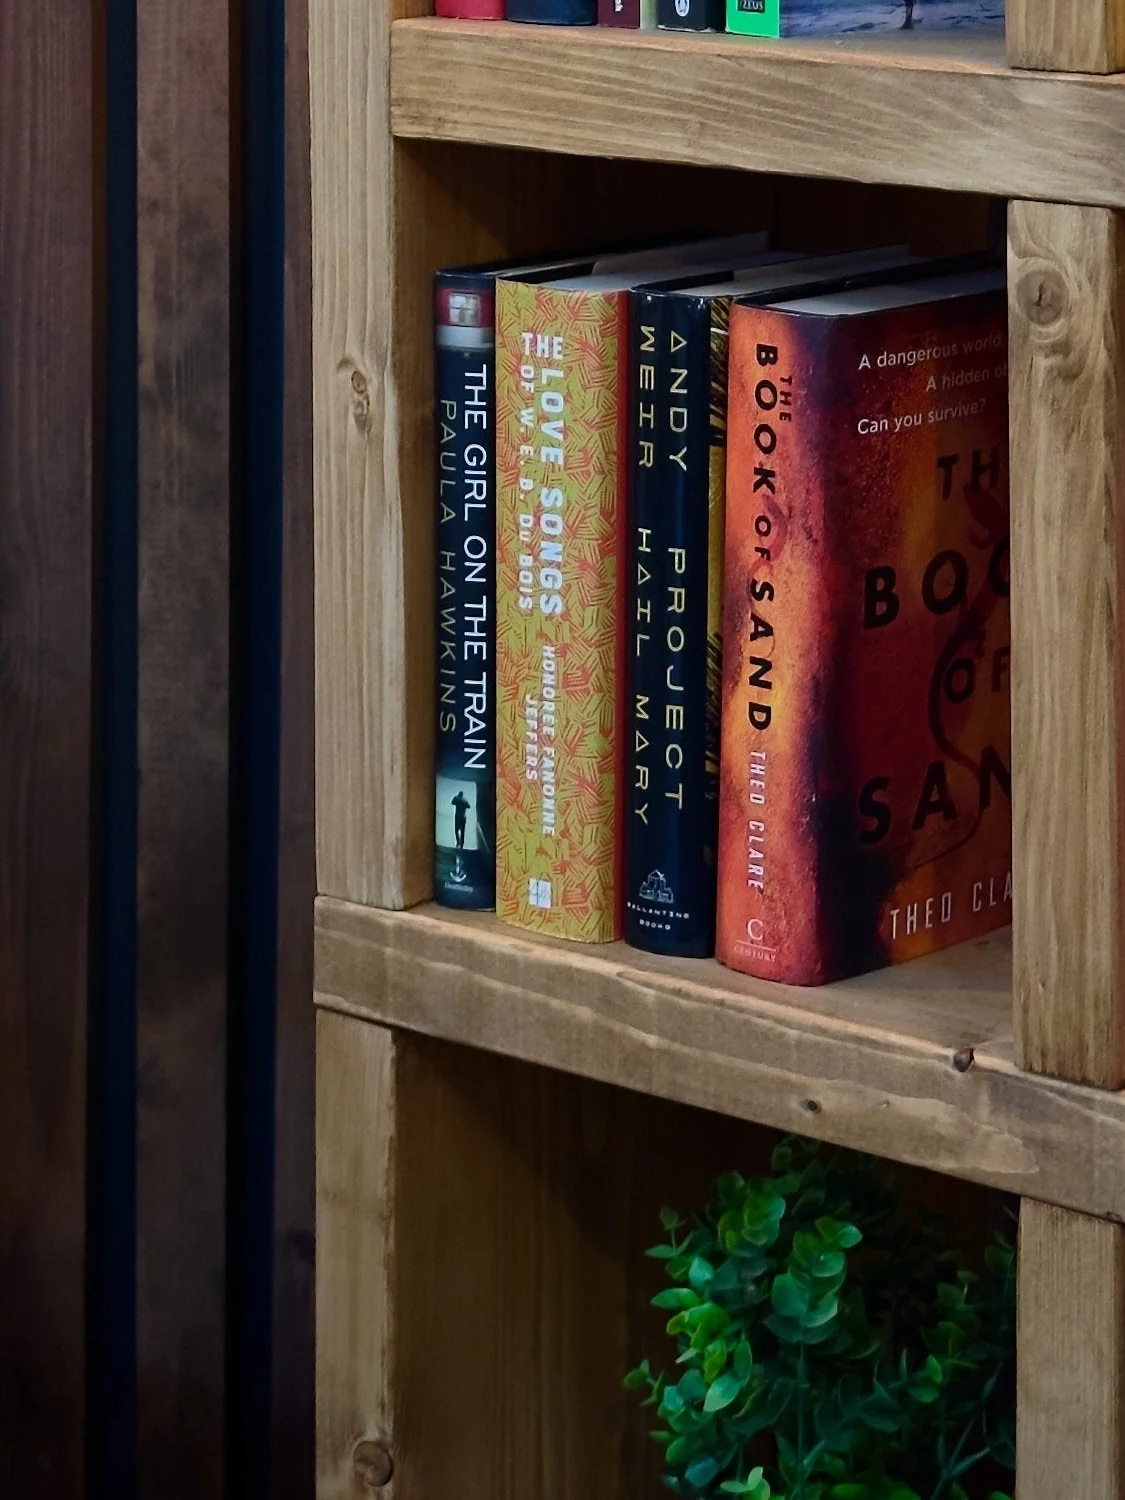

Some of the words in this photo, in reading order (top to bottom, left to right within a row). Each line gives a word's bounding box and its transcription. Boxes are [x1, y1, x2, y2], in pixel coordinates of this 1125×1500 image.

[519, 364, 535, 394] OF
[520, 331, 565, 361] THE
[858, 353, 872, 371] A
[876, 343, 958, 368] dangerous
[925, 375, 938, 393] A
[941, 365, 990, 390] hidden
[463, 363, 488, 431] THE
[539, 366, 565, 467] LOVE
[638, 325, 655, 469] WEIR
[668, 330, 688, 471] ANDY
[752, 343, 779, 495] BOOK
[779, 374, 793, 423] THE
[856, 418, 889, 436] Can
[894, 412, 923, 434] you
[926, 397, 987, 424] survive?
[439, 399, 457, 525] PAULA
[463, 442, 488, 522] GIRL
[463, 535, 488, 583] ON
[539, 486, 565, 616] SONGS
[753, 514, 772, 562] OF
[518, 553, 534, 612] BOIS
[636, 527, 652, 658] HAIL
[438, 550, 457, 734] HAWKINS
[463, 594, 487, 662] THE
[747, 578, 775, 731] SAND
[664, 546, 686, 811] PROJECT
[463, 671, 487, 770] TRAIN
[525, 694, 539, 781] JEFFERS
[634, 694, 650, 826] MARY
[541, 746, 556, 838] FANONNE
[749, 749, 767, 805] THEO
[747, 819, 766, 891] CLARE
[890, 891, 953, 942] THEO
